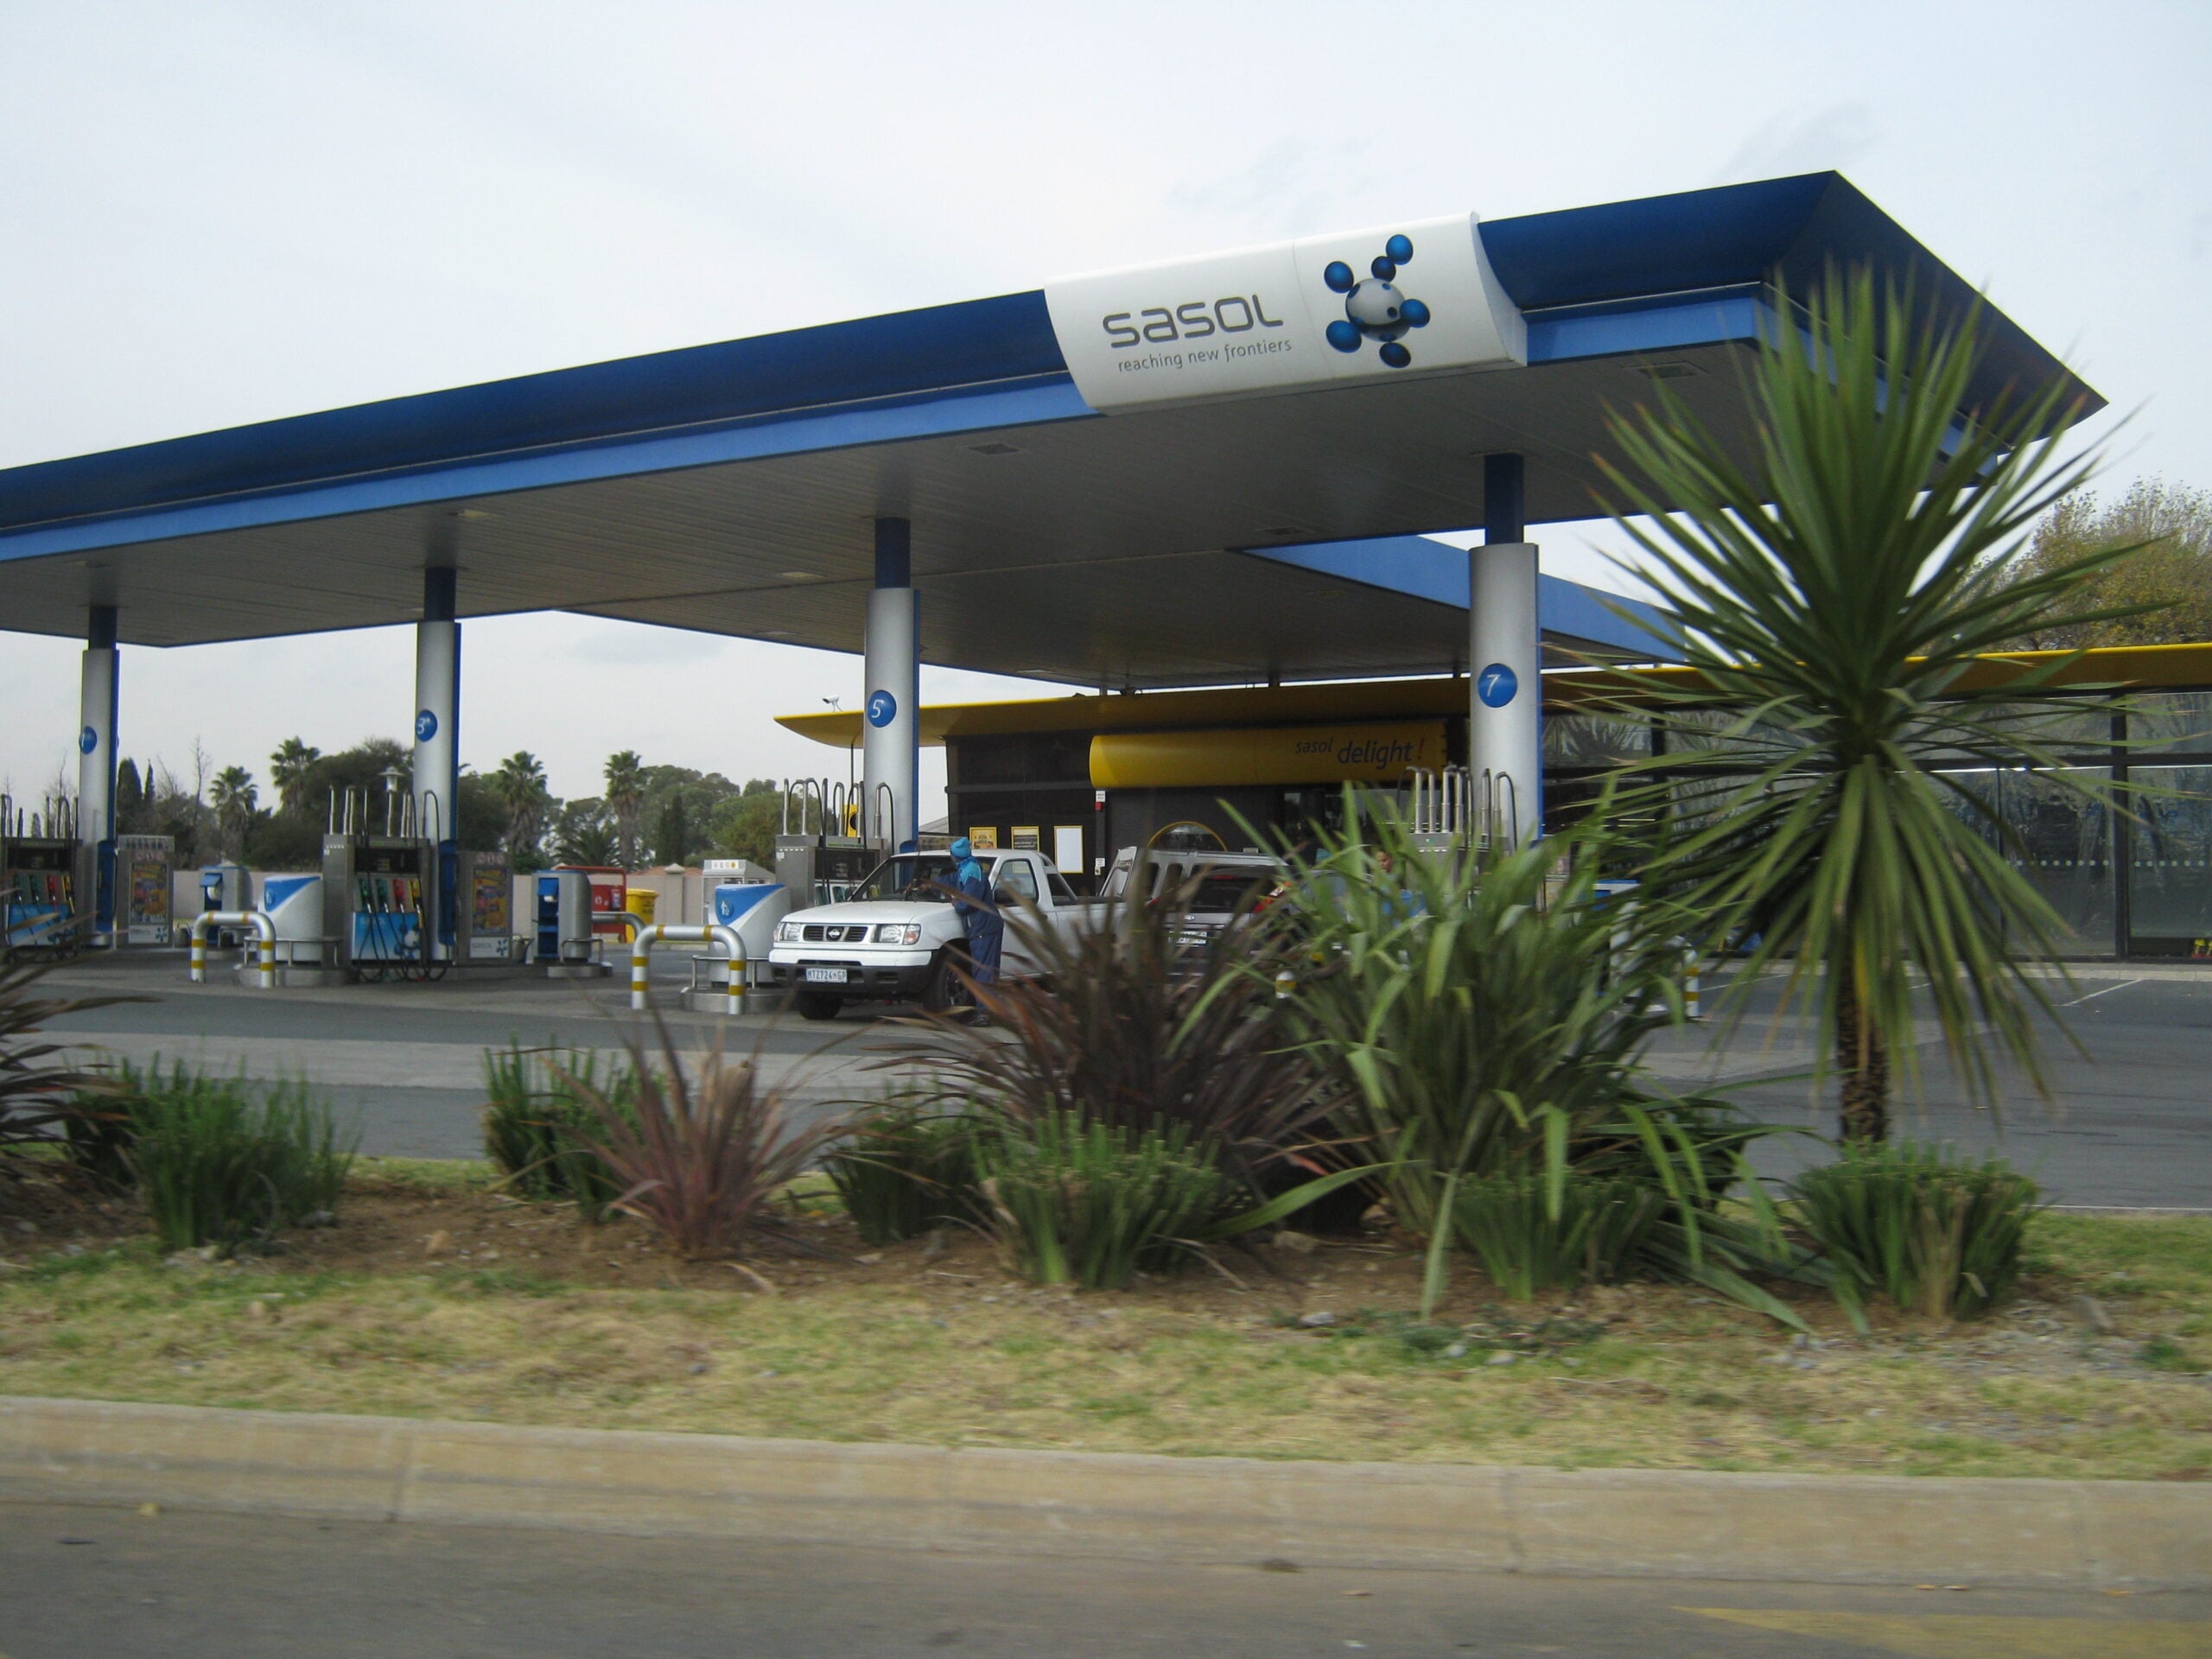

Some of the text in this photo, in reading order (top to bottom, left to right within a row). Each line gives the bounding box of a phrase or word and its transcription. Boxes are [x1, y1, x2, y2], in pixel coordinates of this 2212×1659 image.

[1118, 340, 1292, 372] reaching new frontiers
[1486, 674, 1502, 697] 7
[871, 699, 885, 718] 5
[416, 718, 426, 735] 3
[1295, 737, 1334, 754] sasol
